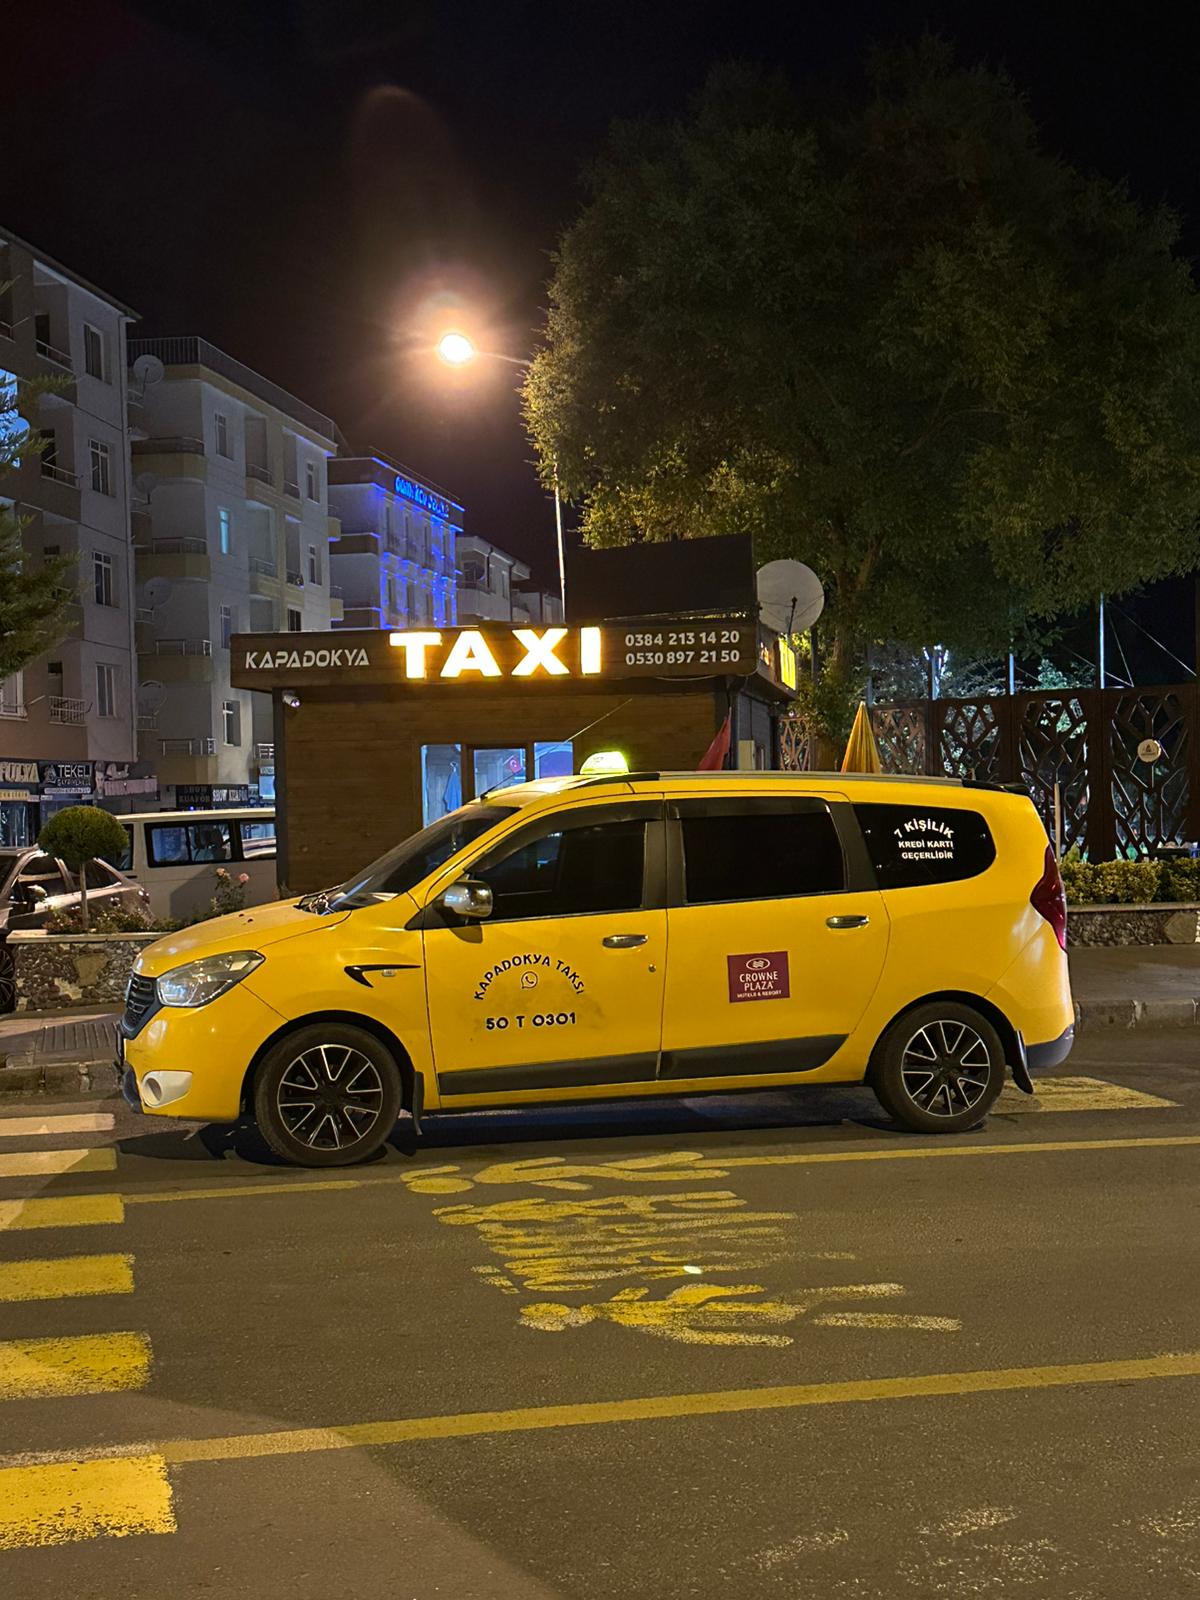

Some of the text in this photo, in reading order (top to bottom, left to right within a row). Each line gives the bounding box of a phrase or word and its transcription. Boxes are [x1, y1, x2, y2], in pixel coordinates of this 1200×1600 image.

[625, 630, 740, 646] 0384 213 14 20
[245, 648, 370, 669] KAPADOKYA
[389, 626, 601, 679] TAXI
[625, 649, 740, 665] 0530 897 21 50
[893, 828, 903, 839] 7
[898, 839, 954, 849] KREDİ KARTI
[901, 850, 954, 861] GEÇERLİDİR
[474, 954, 552, 1000] KAPADOKYA
[740, 971, 778, 982] CROWNE
[744, 981, 774, 992] PLAZA
[486, 1012, 576, 1030] 50 T 0301
